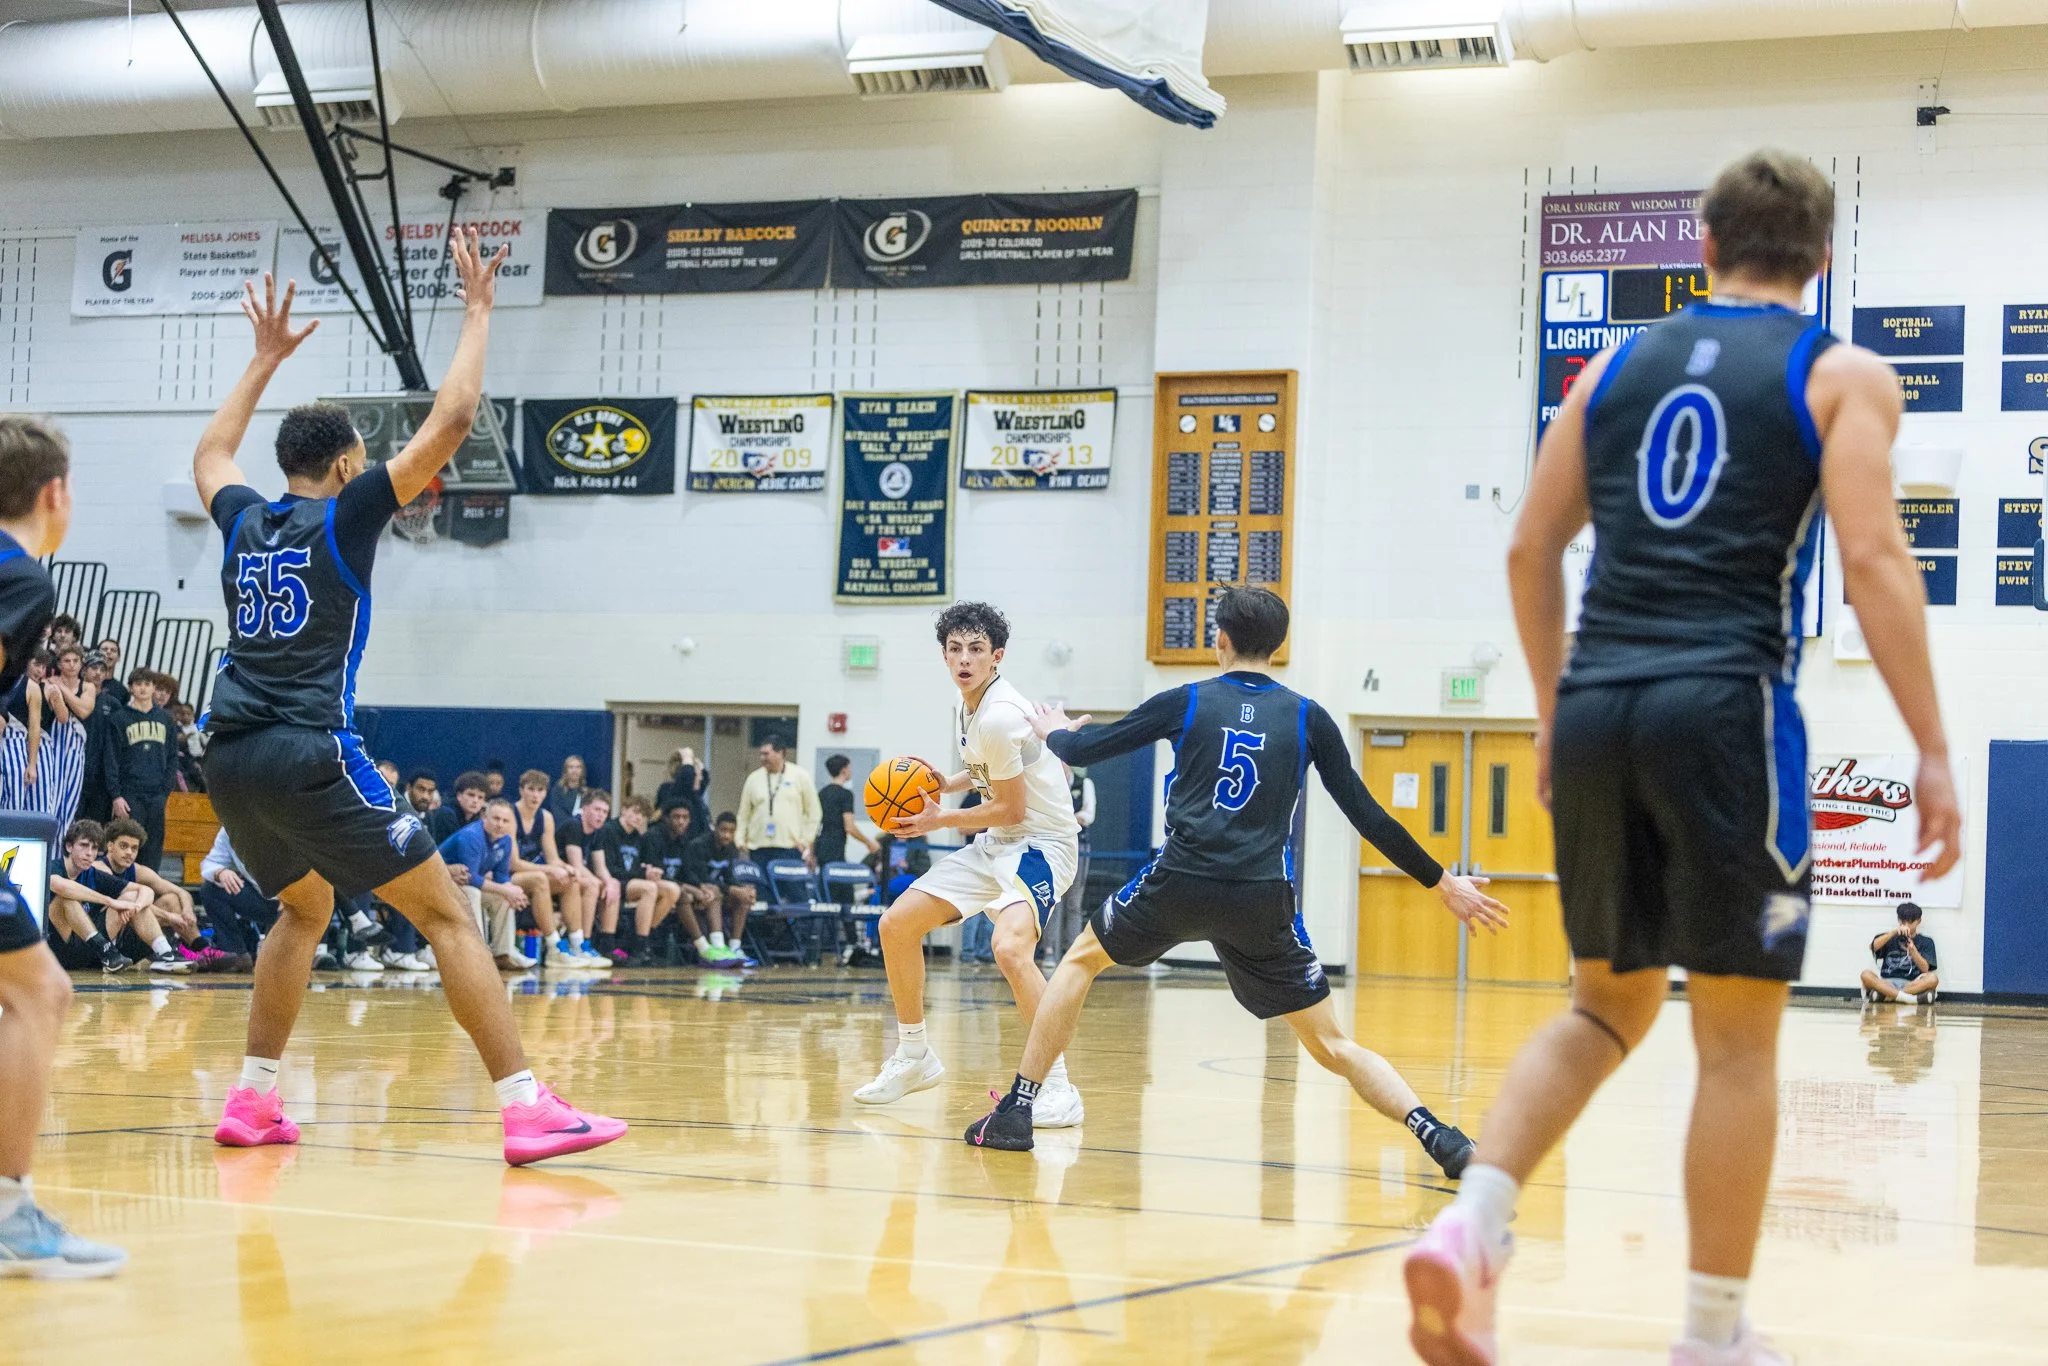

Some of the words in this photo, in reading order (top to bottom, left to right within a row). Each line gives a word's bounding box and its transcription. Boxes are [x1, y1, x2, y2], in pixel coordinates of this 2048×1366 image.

[1544, 203, 1572, 213] ORAL
[1574, 201, 1621, 212] SURGERY
[1631, 200, 1677, 210] WISDOM
[961, 218, 1032, 235] QUINCEY
[1035, 216, 1104, 232] NOONAN
[180, 233, 223, 244] MELISSA
[226, 231, 260, 242] JONES
[668, 228, 722, 244] SHELBY
[726, 226, 796, 242] BABCOCK
[1551, 223, 1590, 245] DR.
[1599, 220, 1667, 244] ALAN
[998, 238, 1043, 248] COLORADO
[183, 252, 209, 261] State
[210, 250, 257, 260] Basketball
[1033, 248, 1063, 258] PLAYER
[1065, 248, 1076, 258] OF
[1077, 248, 1091, 257] THE
[1092, 246, 1114, 256] YEAR
[1544, 249, 1626, 264] 303.665.2377
[702, 258, 729, 268] PLAYER
[730, 258, 742, 268] OF
[743, 258, 756, 267] THE
[757, 256, 778, 266] YEAR
[179, 268, 206, 278] Player
[210, 267, 221, 276] of
[222, 266, 236, 276] the
[238, 266, 259, 276] Year
[191, 290, 245, 300] 2006-2007
[85, 298, 110, 306] PLAYER
[1882, 318, 1934, 328] SOFTBALL
[1894, 328, 1920, 338] 2013
[718, 414, 804, 434] WRESTLING
[994, 409, 1085, 430] WRESTLING
[1005, 432, 1072, 444] CHAMPIONSHIPS
[710, 448, 738, 468] 20
[783, 448, 812, 468] 09
[991, 446, 1018, 466] 20
[1068, 444, 1092, 465] 13
[1636, 383, 1730, 529] 0
[553, 475, 578, 488] Nick
[1998, 576, 2029, 585] SWIM
[236, 546, 315, 639] 55
[1452, 678, 1476, 698] EXIT
[1240, 704, 1256, 724] B
[1212, 726, 1266, 812] 5
[1846, 805, 1892, 817] ELECTRIC
[1850, 842, 1887, 851] Reliable
[1848, 876, 1860, 884] of
[1862, 874, 1880, 884] the
[1826, 888, 1882, 898] Basketball
[1883, 889, 1912, 898] Team
